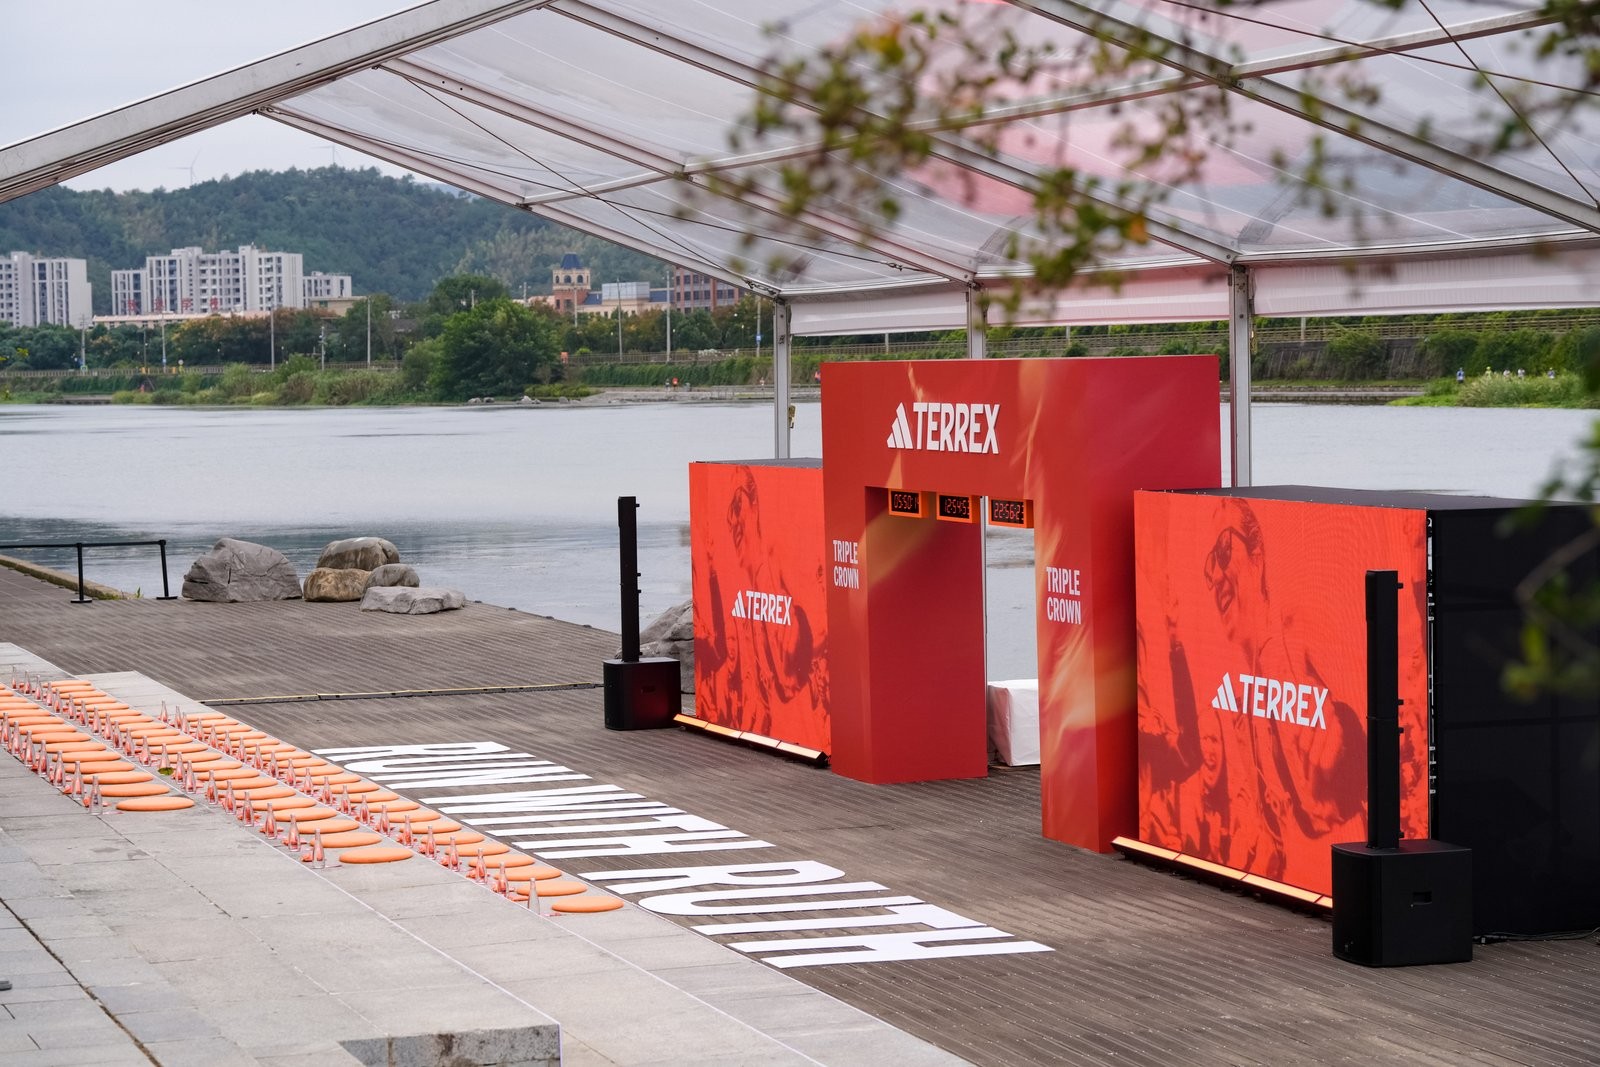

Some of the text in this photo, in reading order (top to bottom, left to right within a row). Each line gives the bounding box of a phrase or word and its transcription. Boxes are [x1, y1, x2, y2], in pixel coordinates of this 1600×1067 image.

[913, 402, 1000, 454] TERREX
[832, 539, 859, 565] TRIPLE
[833, 565, 860, 590] CROWN
[1046, 566, 1081, 596] TRIPLE
[745, 589, 792, 626] TERREX
[1046, 596, 1082, 625] CROWN
[1239, 673, 1329, 730] TERREX
[310, 741, 1056, 969] RUN WITH RUTH
